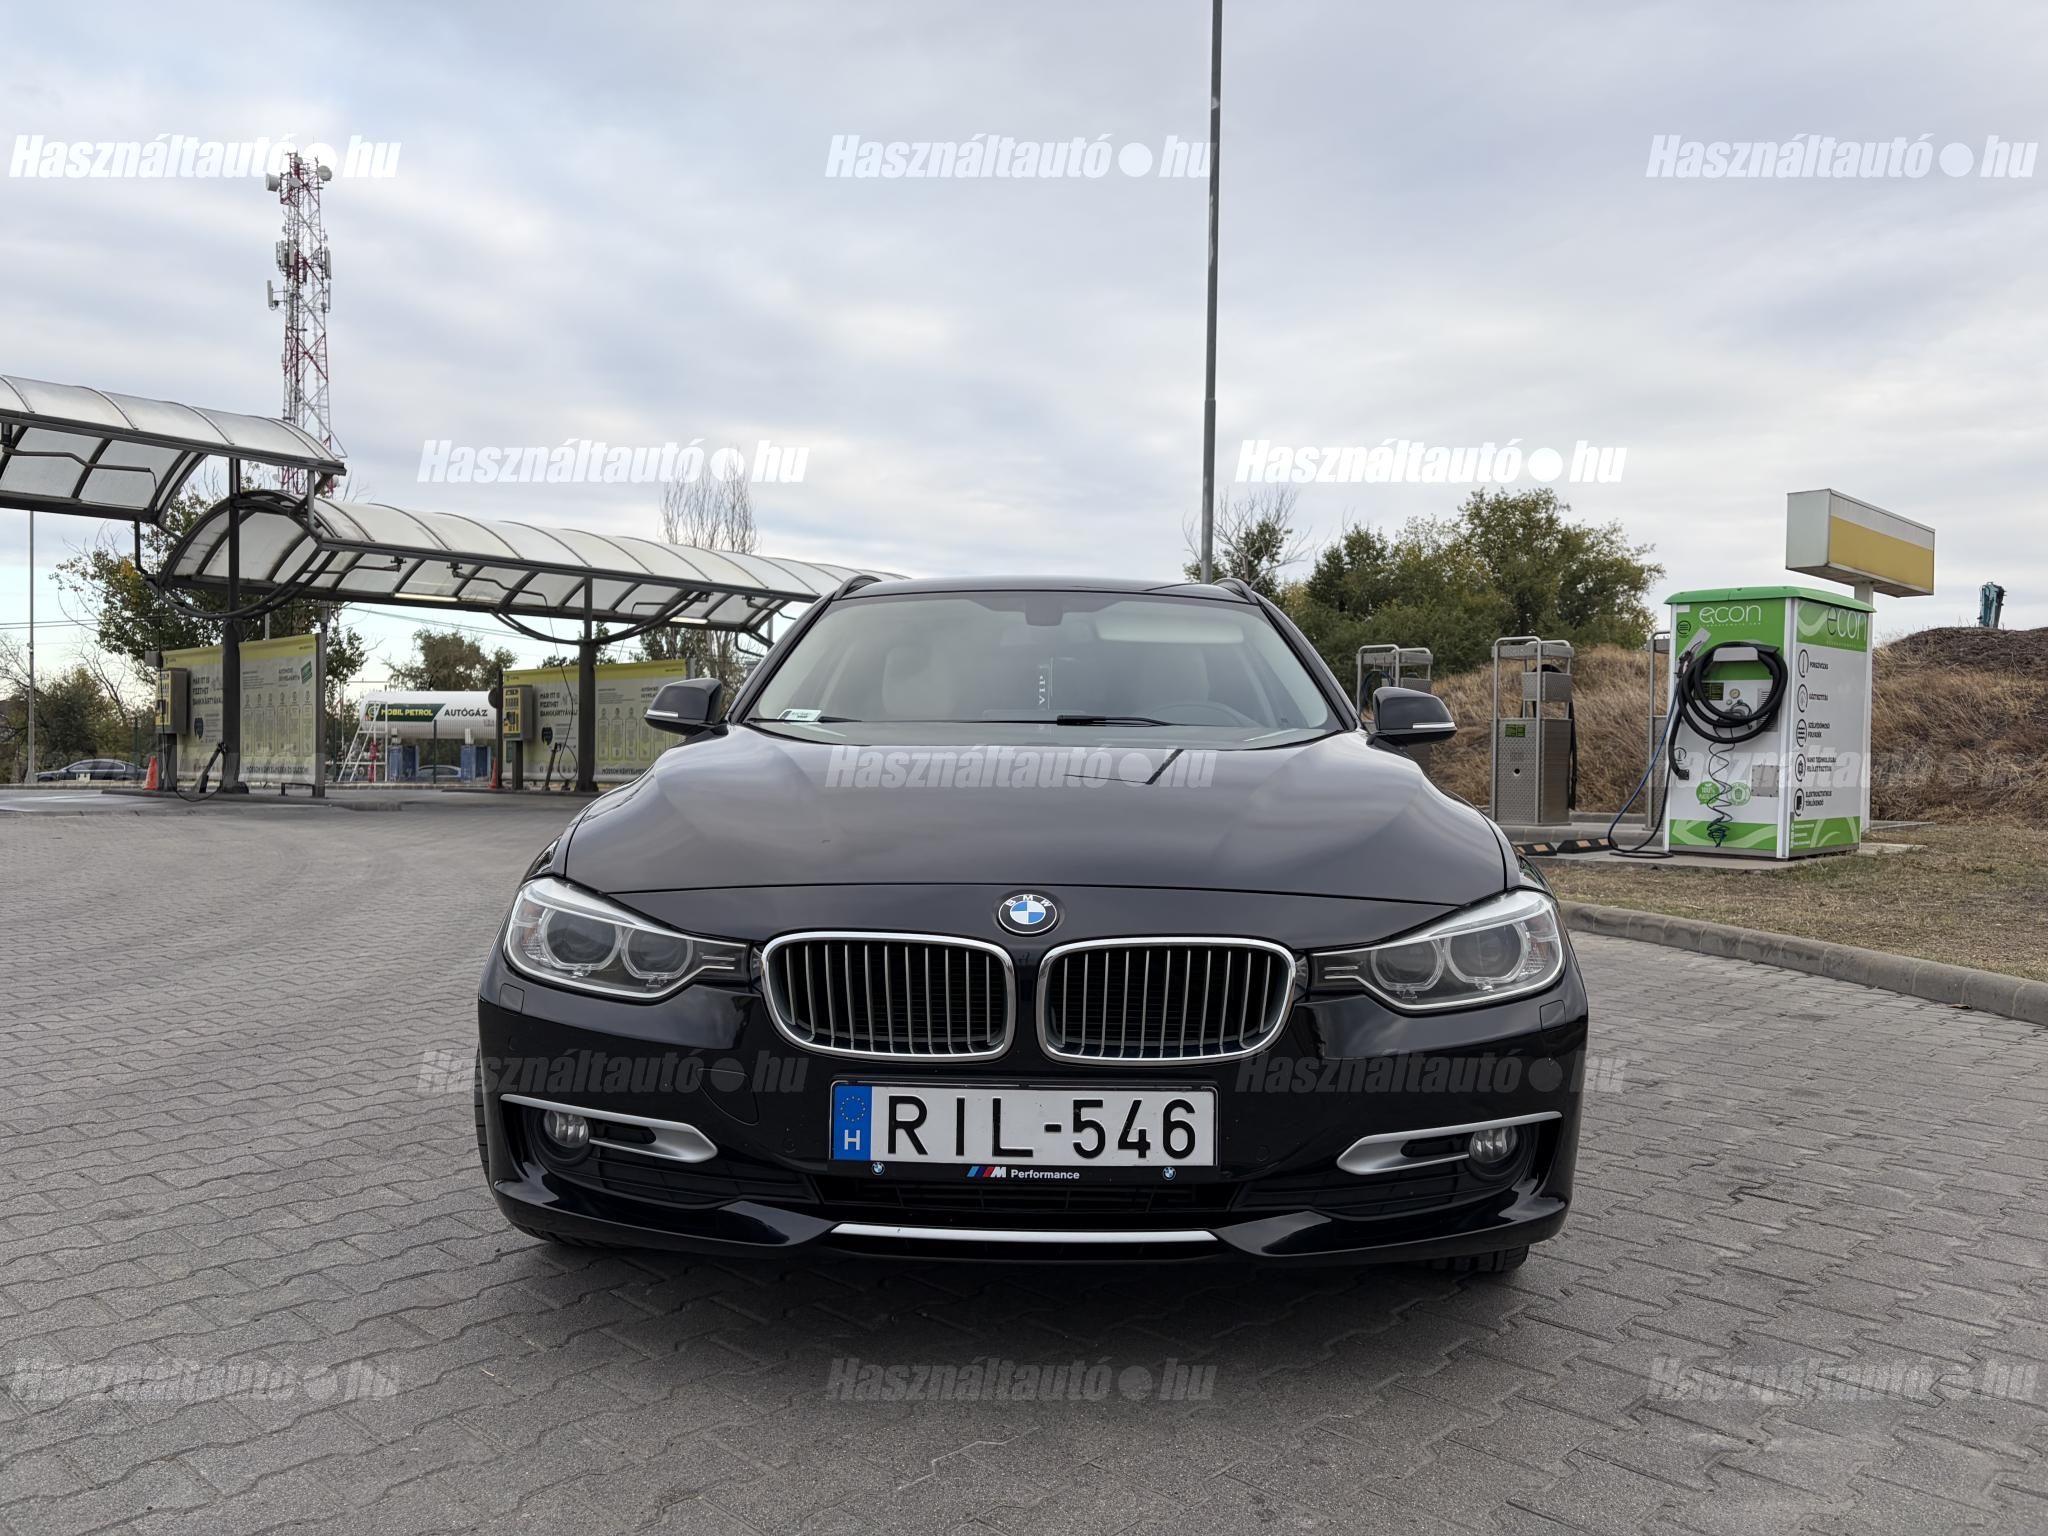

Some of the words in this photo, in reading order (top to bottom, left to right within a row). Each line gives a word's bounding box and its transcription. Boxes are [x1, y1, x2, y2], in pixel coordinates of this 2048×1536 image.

[1699, 605, 1762, 625] econ
[1827, 606, 1867, 640] econ
[381, 709, 404, 717] MOBIL
[405, 708, 433, 717] PETROL
[444, 708, 488, 717] AUTÓGÁZ
[887, 1095, 1196, 1160] RIL-546
[844, 1129, 862, 1151] H
[1010, 1168, 1080, 1180] Performance
